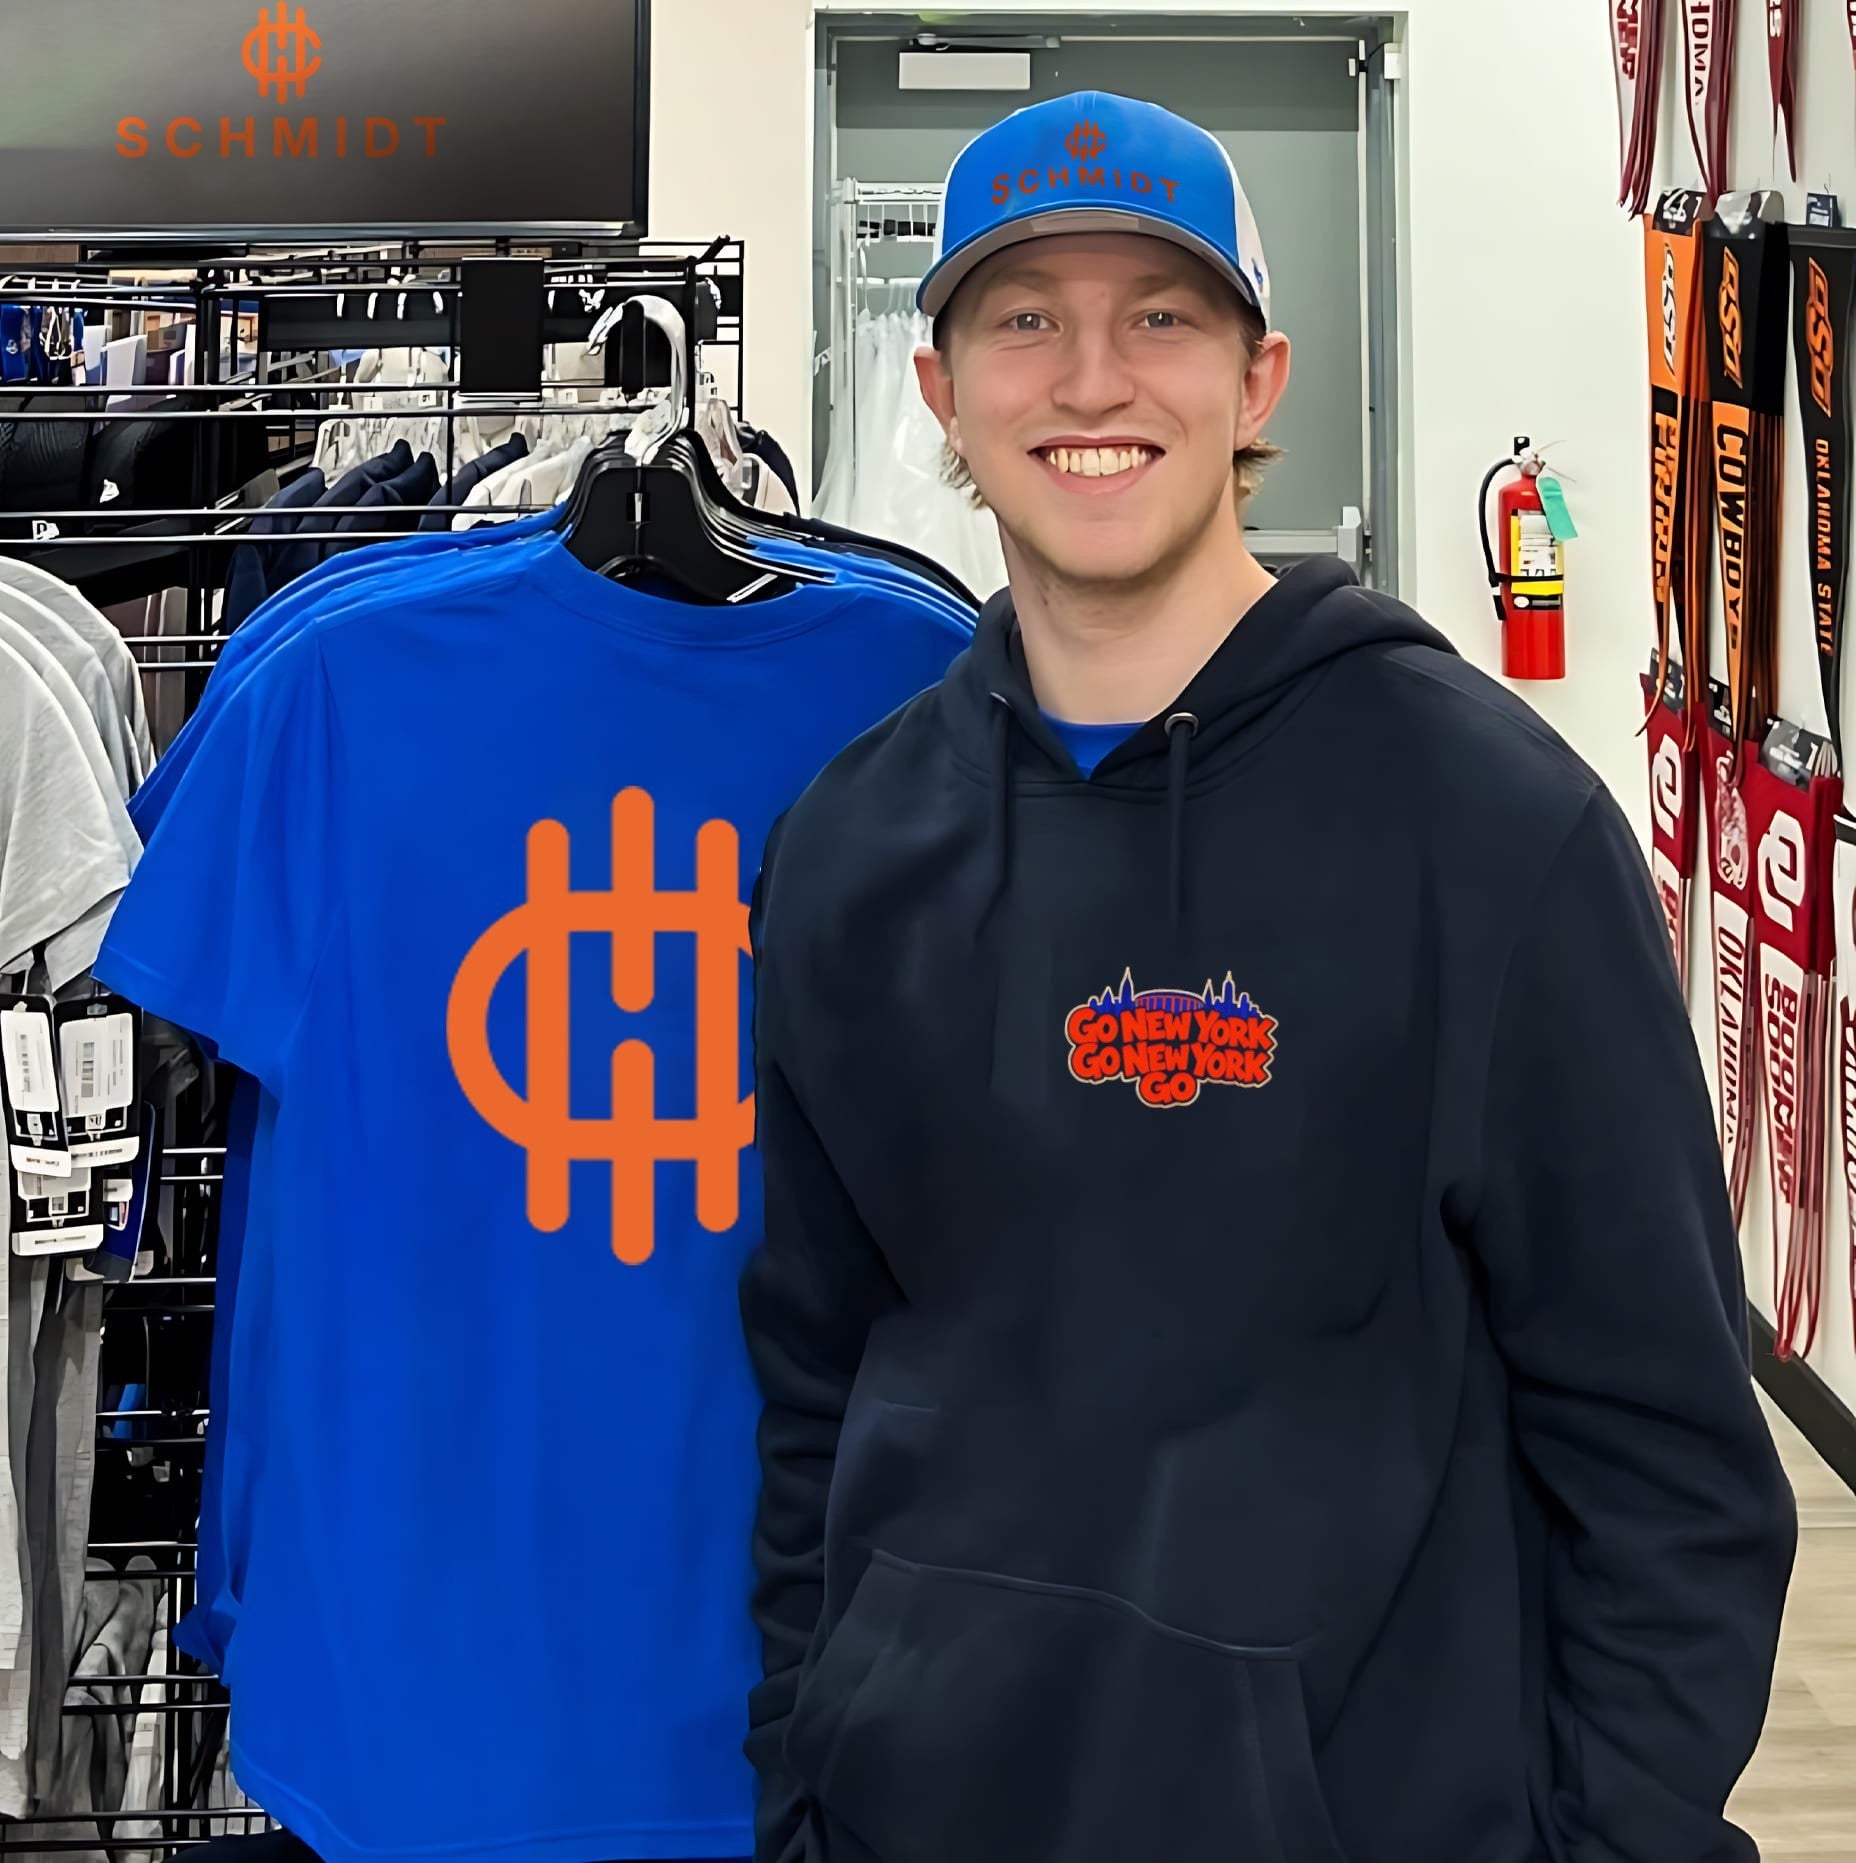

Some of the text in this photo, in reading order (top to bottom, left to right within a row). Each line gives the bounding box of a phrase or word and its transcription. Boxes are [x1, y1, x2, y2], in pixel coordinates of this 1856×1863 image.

[115, 117, 447, 158] SCHMIDT
[990, 166, 1180, 205] SCHMIDT
[1815, 438, 1832, 571] OKLAHOMA
[1717, 924, 1746, 1144] OKLAHOMA
